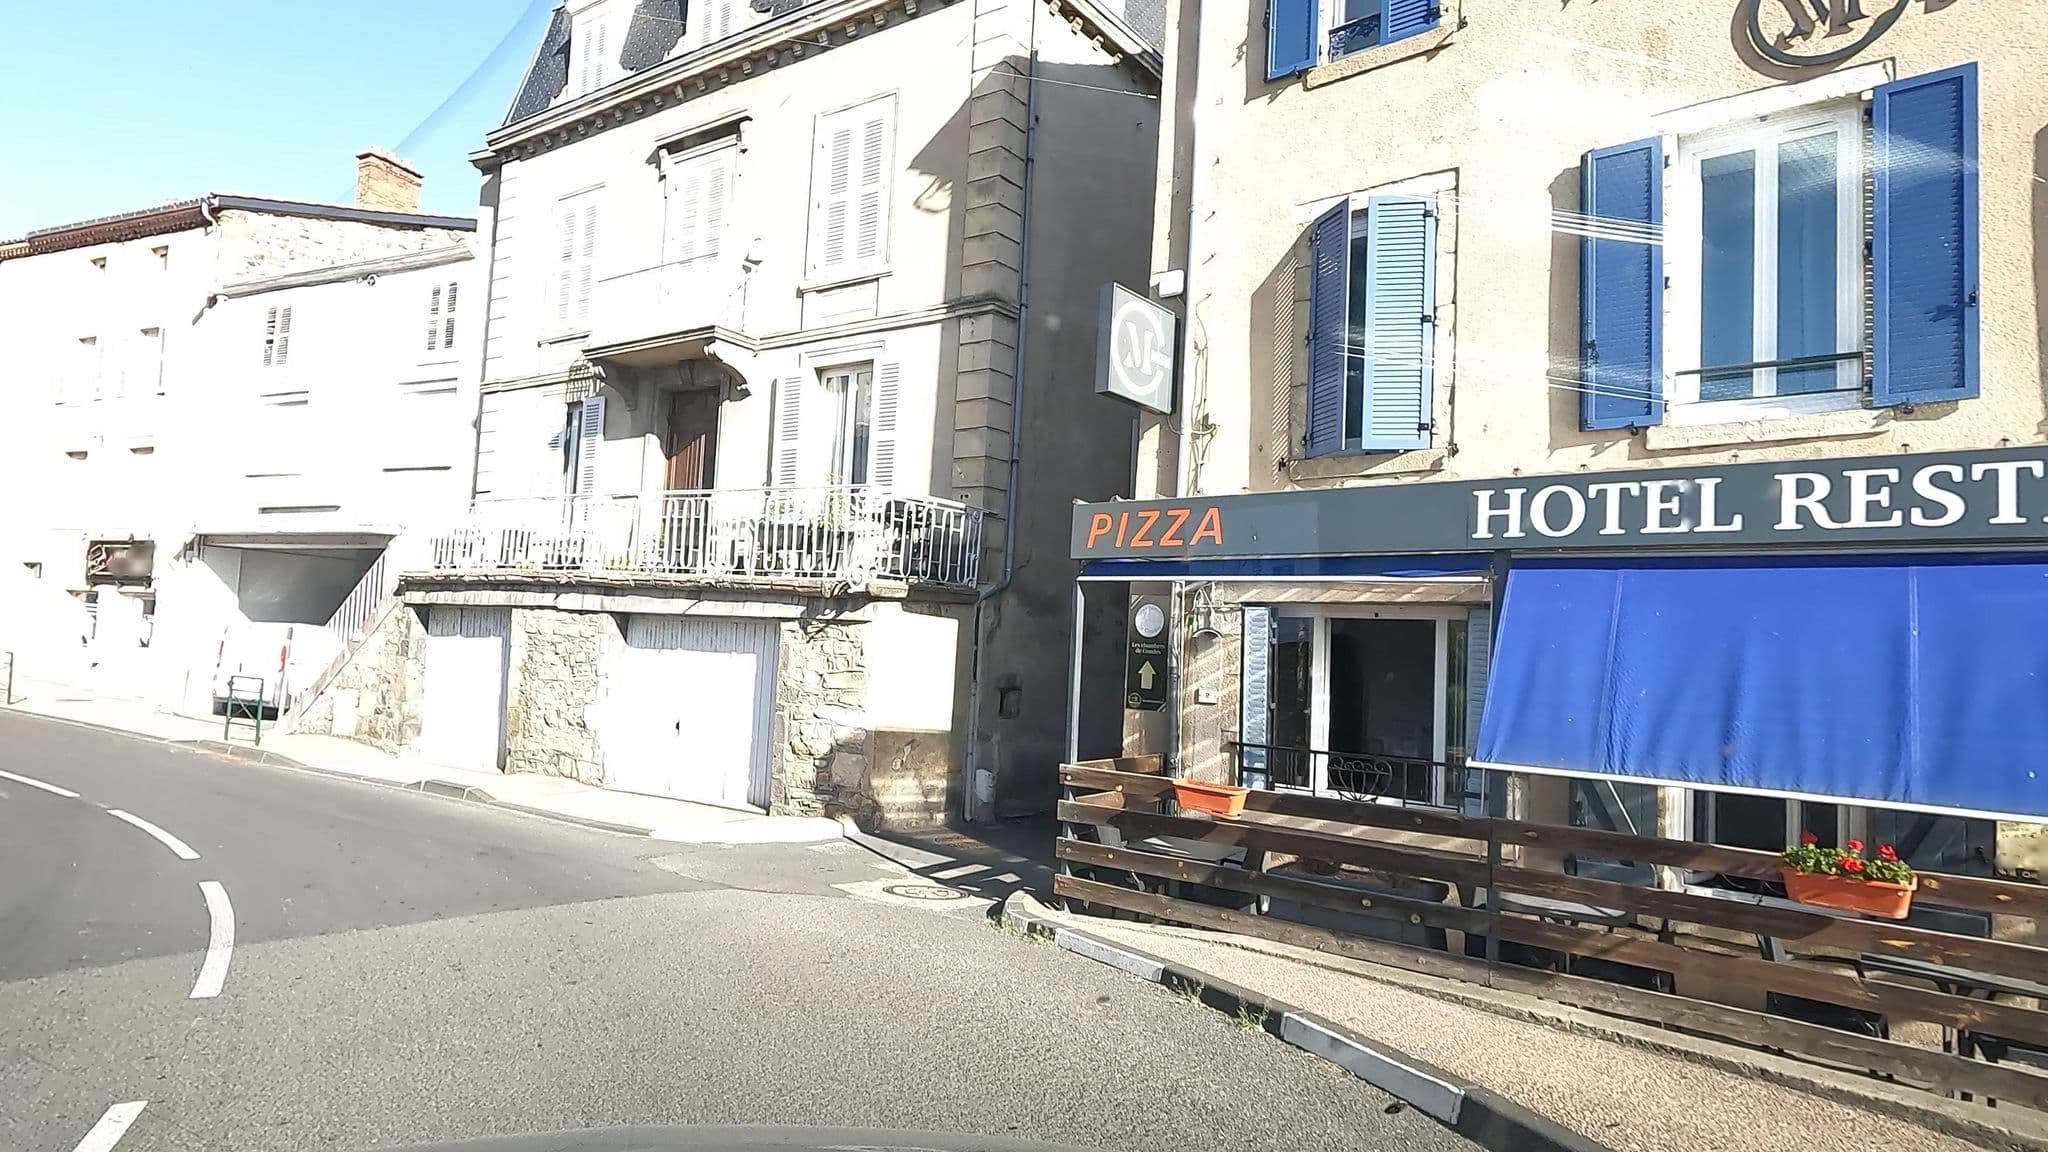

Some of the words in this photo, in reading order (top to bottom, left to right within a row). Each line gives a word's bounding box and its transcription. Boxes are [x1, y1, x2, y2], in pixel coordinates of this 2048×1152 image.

[1086, 506, 1224, 549] PIZZA
[1471, 477, 1744, 539] HOTEL
[1772, 459, 2048, 531] REST
